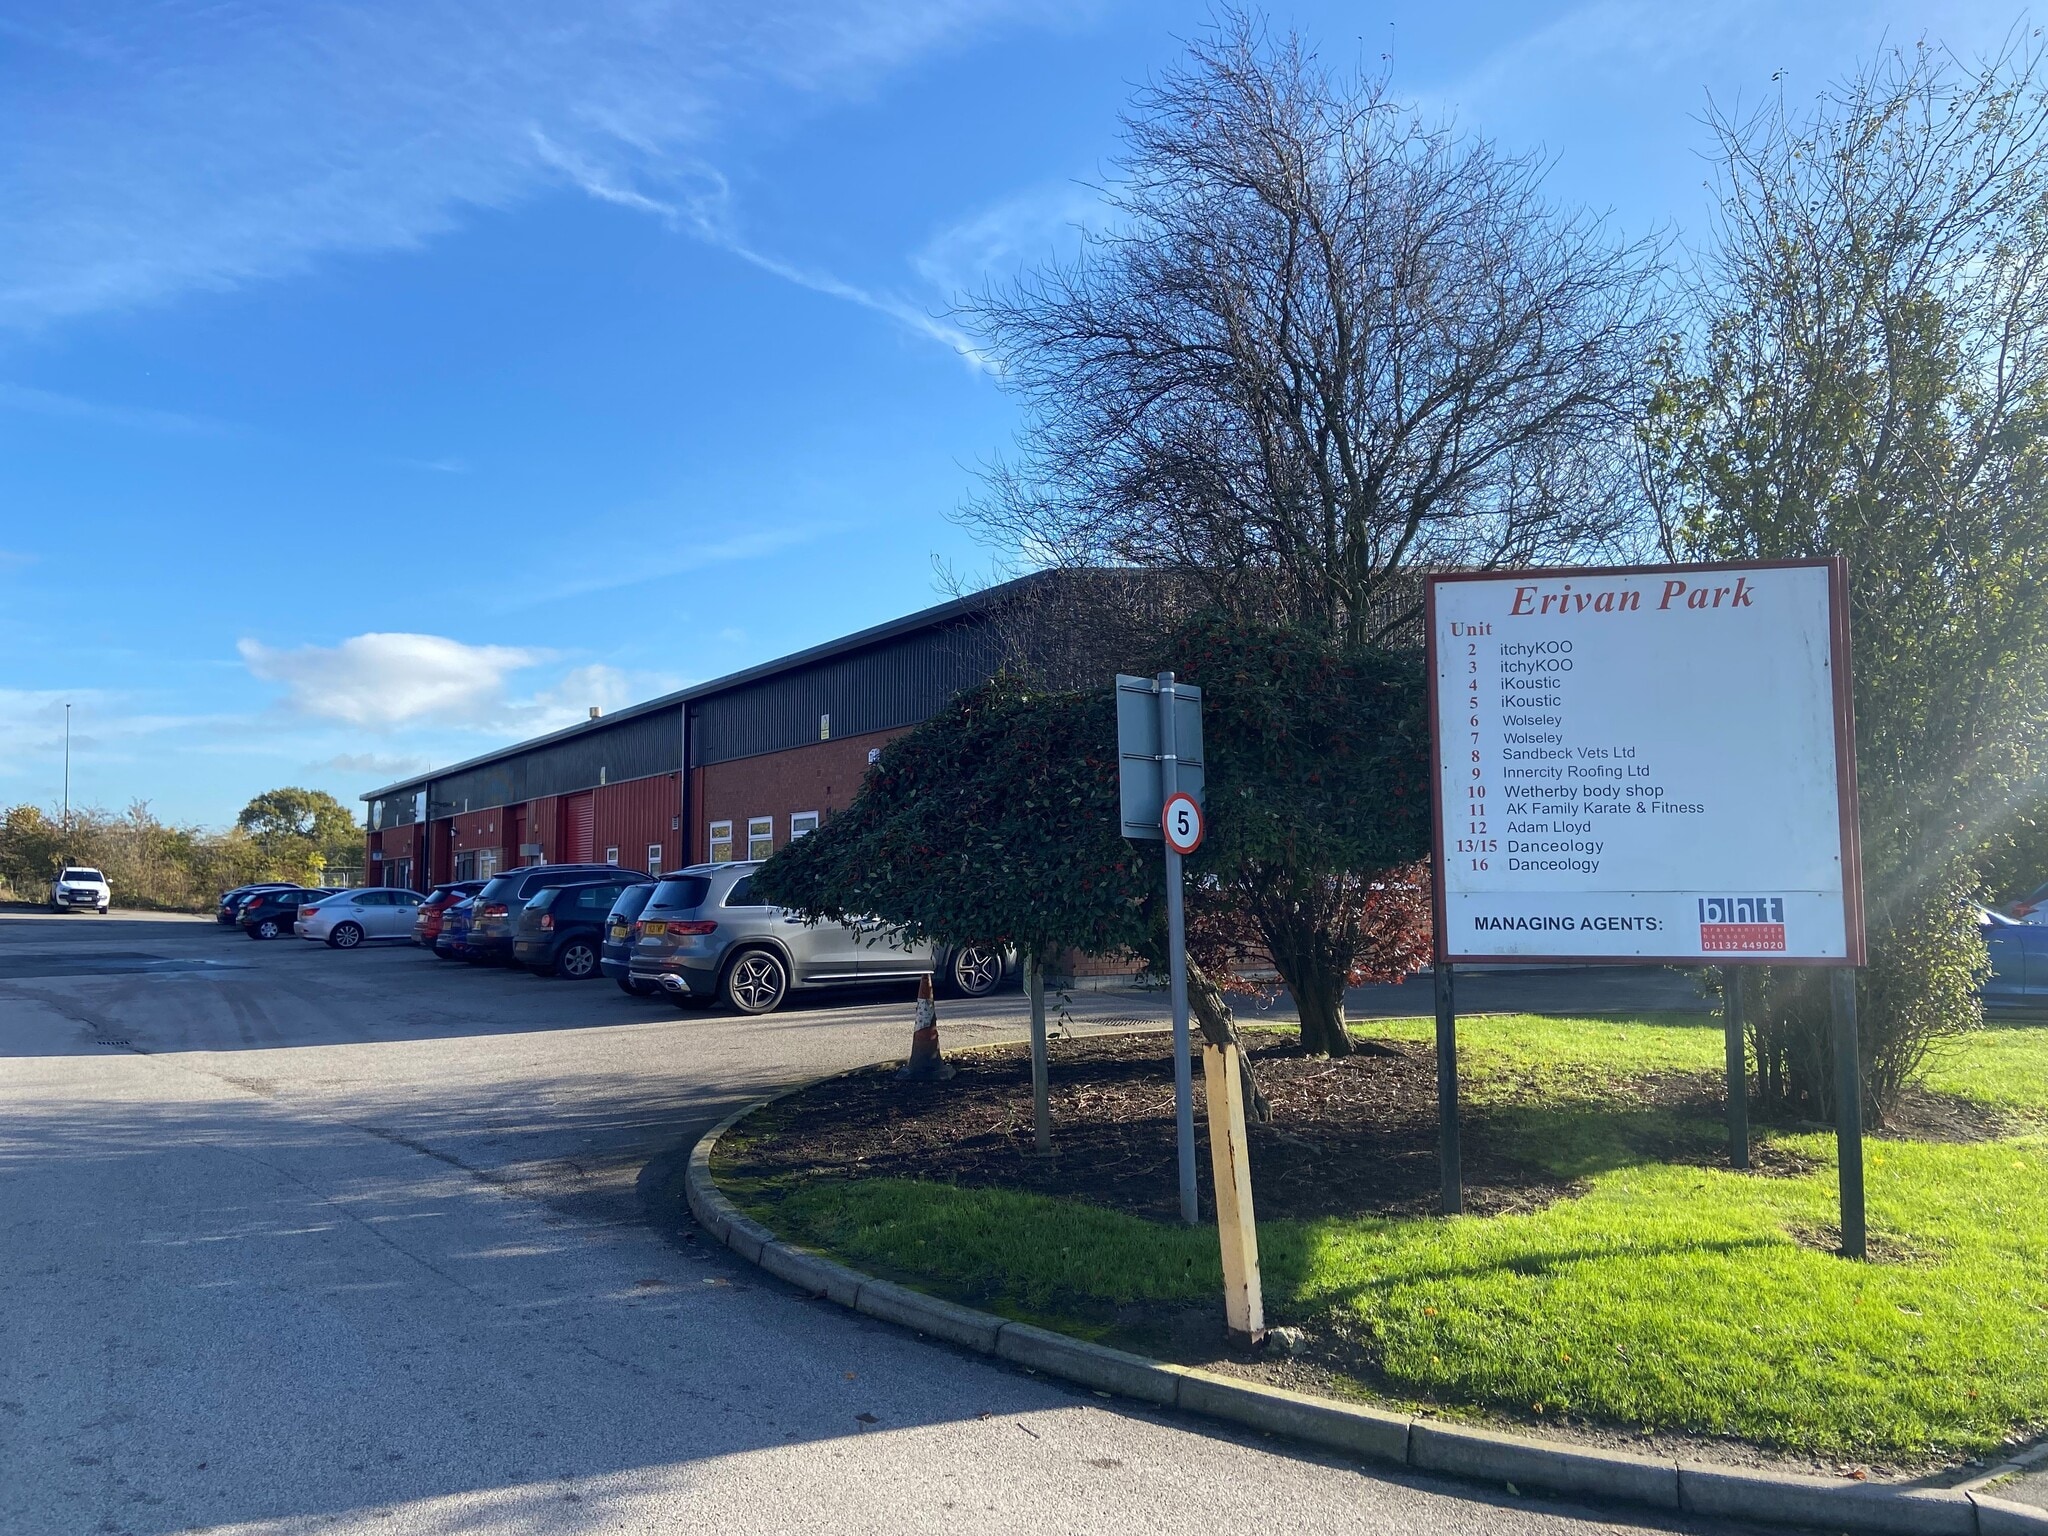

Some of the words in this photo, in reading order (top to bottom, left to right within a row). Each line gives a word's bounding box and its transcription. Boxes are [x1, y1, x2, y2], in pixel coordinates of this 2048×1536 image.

[1508, 585, 1641, 616] Erivan
[1656, 577, 1756, 611] Park
[1450, 621, 1493, 637] Unit
[1467, 643, 1477, 656] 2
[1500, 640, 1573, 658] itchyKOO
[1468, 661, 1477, 674] 3
[1500, 658, 1573, 675] itchyKOO
[1468, 679, 1478, 691] 4
[1500, 676, 1561, 690] iKoustic
[1469, 696, 1478, 709] 5
[1501, 694, 1562, 708] iKoustic
[1470, 714, 1479, 727] 6
[1502, 714, 1562, 728] Wolseley
[1470, 732, 1479, 745] 7
[1503, 732, 1563, 746] Wolseley
[1471, 749, 1480, 763] 8
[1502, 747, 1573, 761] Sandbeck
[1577, 747, 1609, 759] Vets
[1613, 746, 1636, 759] Ltd
[1471, 767, 1481, 780] 9
[1503, 766, 1563, 781] Innercity
[1567, 765, 1623, 780] Roofing
[1627, 764, 1650, 777] Ltd
[1467, 785, 1486, 799] 10
[1504, 785, 1578, 800] Wetherby
[1583, 784, 1621, 799] body
[1626, 784, 1664, 798] shop
[1469, 803, 1486, 816] 11
[1506, 803, 1528, 815] AK
[1532, 802, 1579, 816] Family
[1584, 802, 1631, 814] Karate
[1636, 802, 1647, 814] &
[1651, 801, 1705, 814] Fitness
[1177, 811, 1189, 835] 5
[1469, 821, 1487, 834] 12
[1507, 821, 1548, 834] Adam
[1553, 820, 1591, 835] Lloyd
[1457, 839, 1498, 853] 13/15
[1508, 839, 1604, 855] Danceology
[1471, 858, 1489, 872] 16
[1508, 857, 1600, 873] Danceology
[1474, 916, 1576, 931] MANAGING
[1580, 916, 1664, 931] AGENTS:
[1704, 941, 1738, 950] 01132
[1742, 941, 1784, 950] 449020
